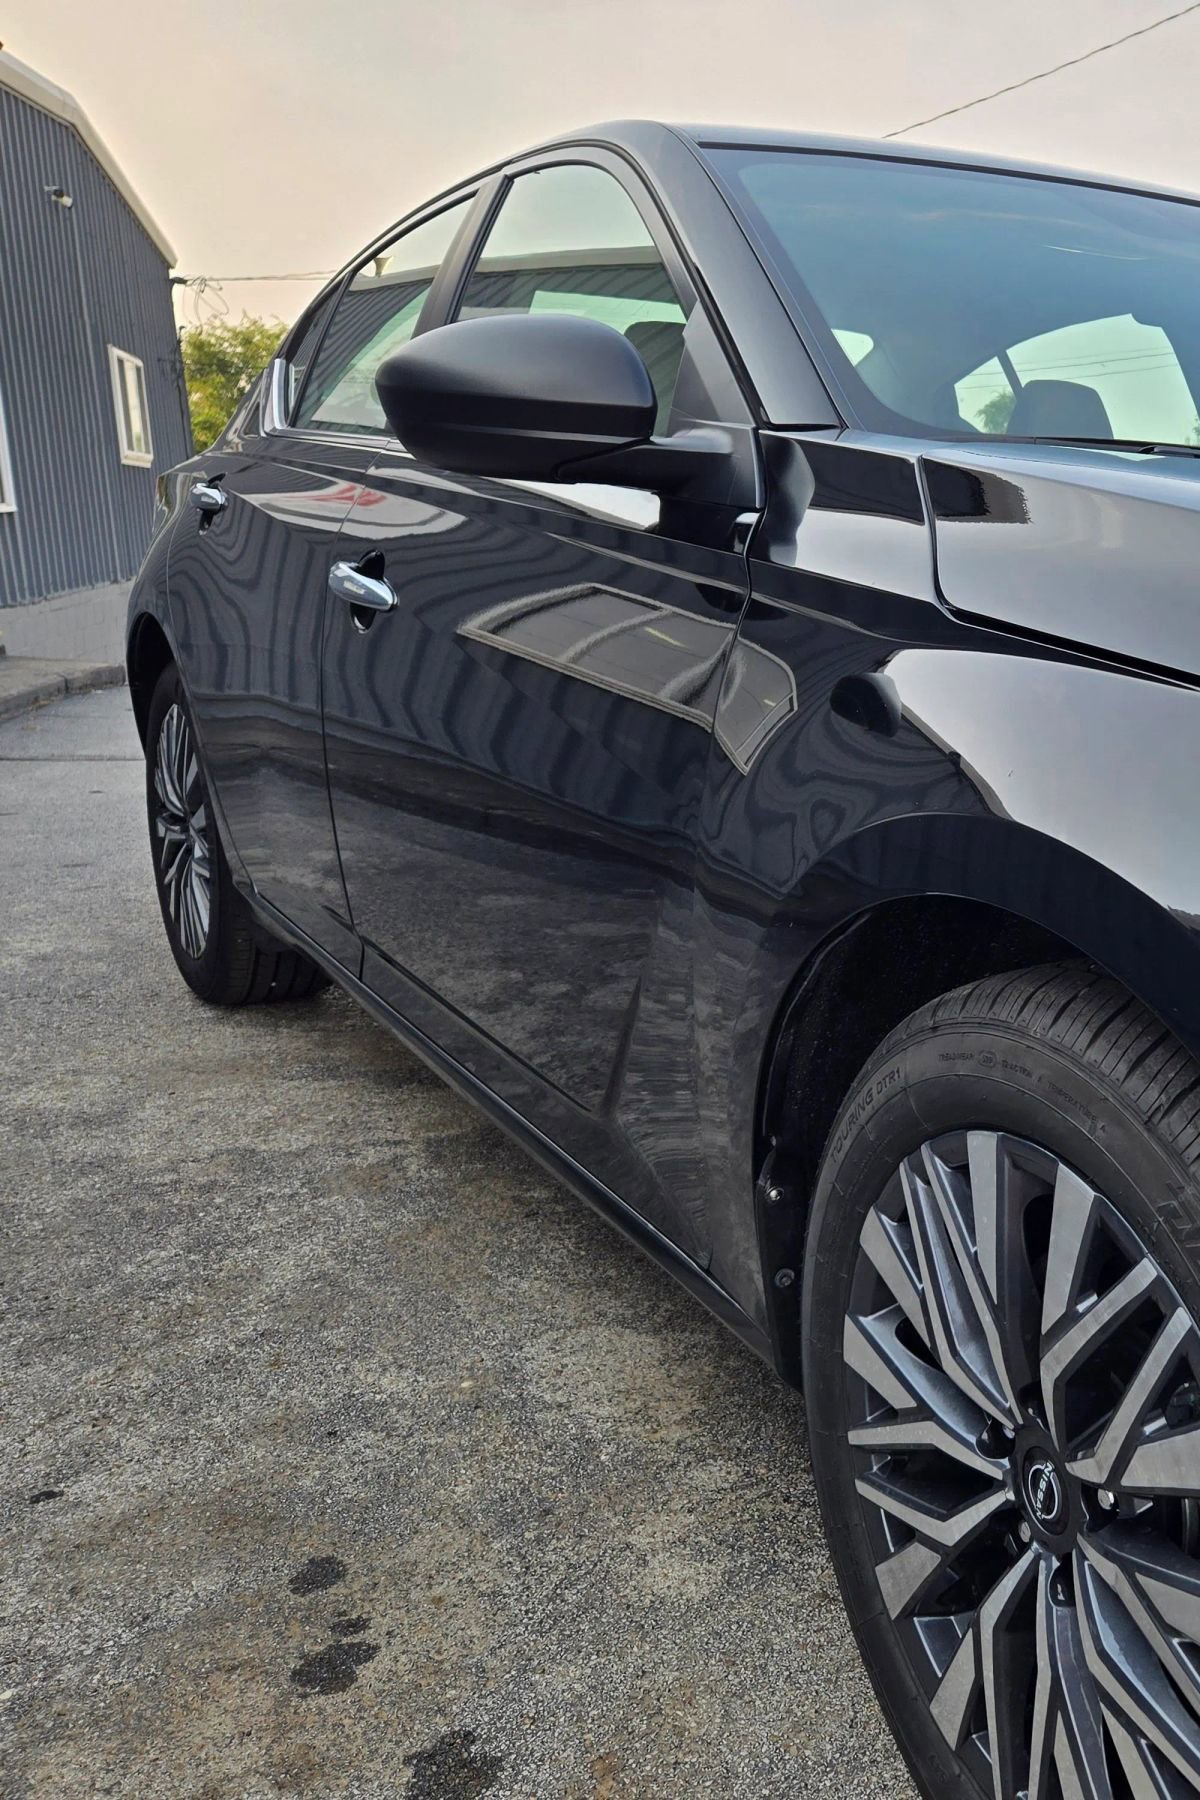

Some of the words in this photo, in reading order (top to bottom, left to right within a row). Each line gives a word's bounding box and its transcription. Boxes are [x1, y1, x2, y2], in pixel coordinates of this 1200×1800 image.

[830, 1087, 874, 1162] TOURING
[876, 1067, 901, 1095] DTR1
[1036, 1461, 1055, 1520] NISSAN
